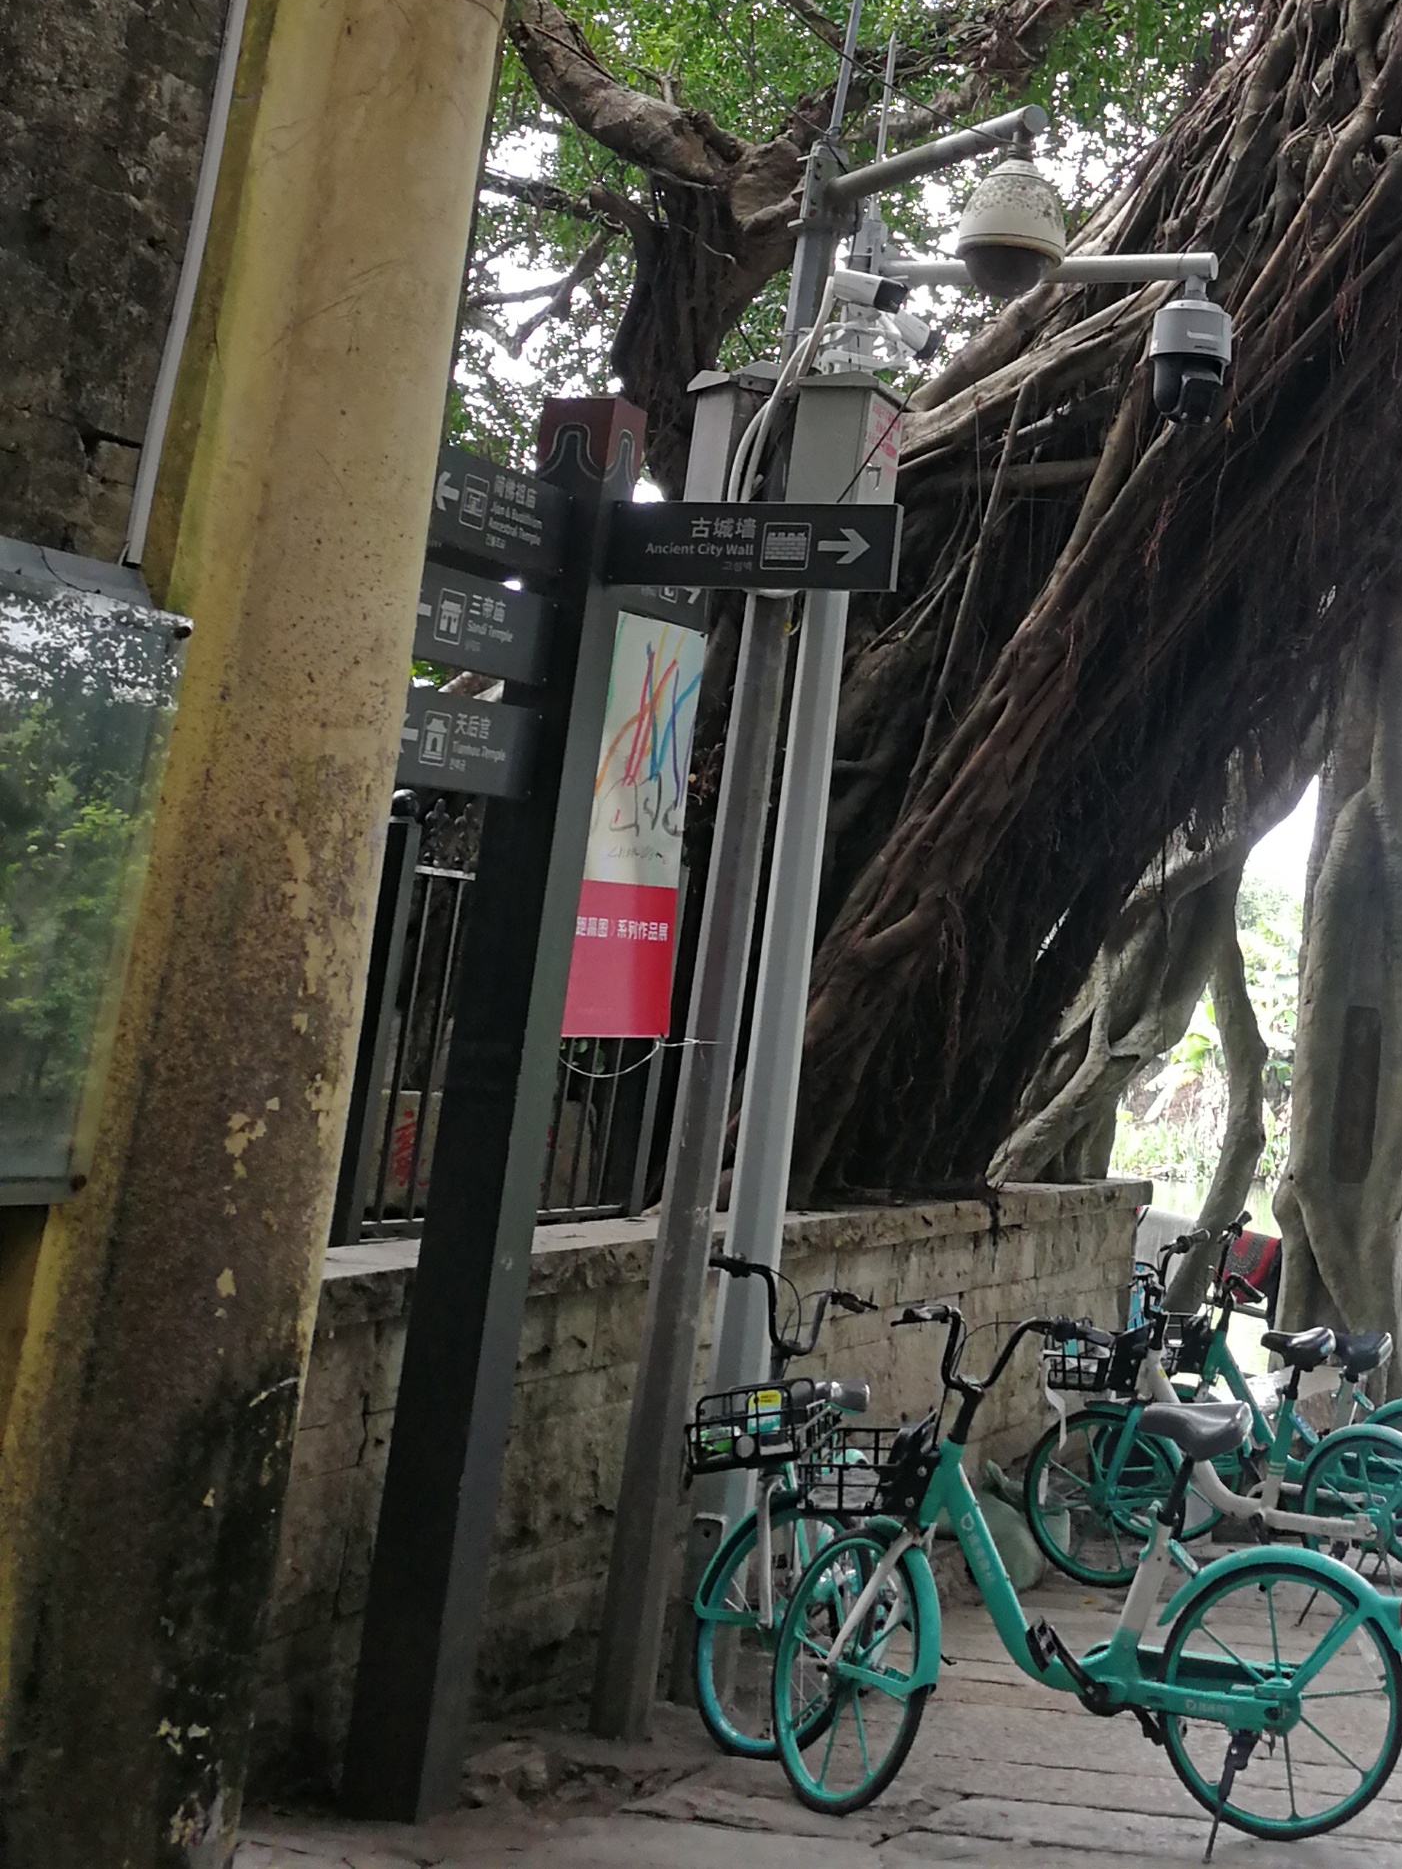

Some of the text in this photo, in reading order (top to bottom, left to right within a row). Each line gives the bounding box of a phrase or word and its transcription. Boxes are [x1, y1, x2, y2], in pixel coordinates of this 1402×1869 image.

[691, 517, 757, 539] 古城墙
[645, 541, 754, 558] Ancient City Wall
[468, 593, 507, 624] 三帝庙
[453, 712, 492, 741] 天后宫
